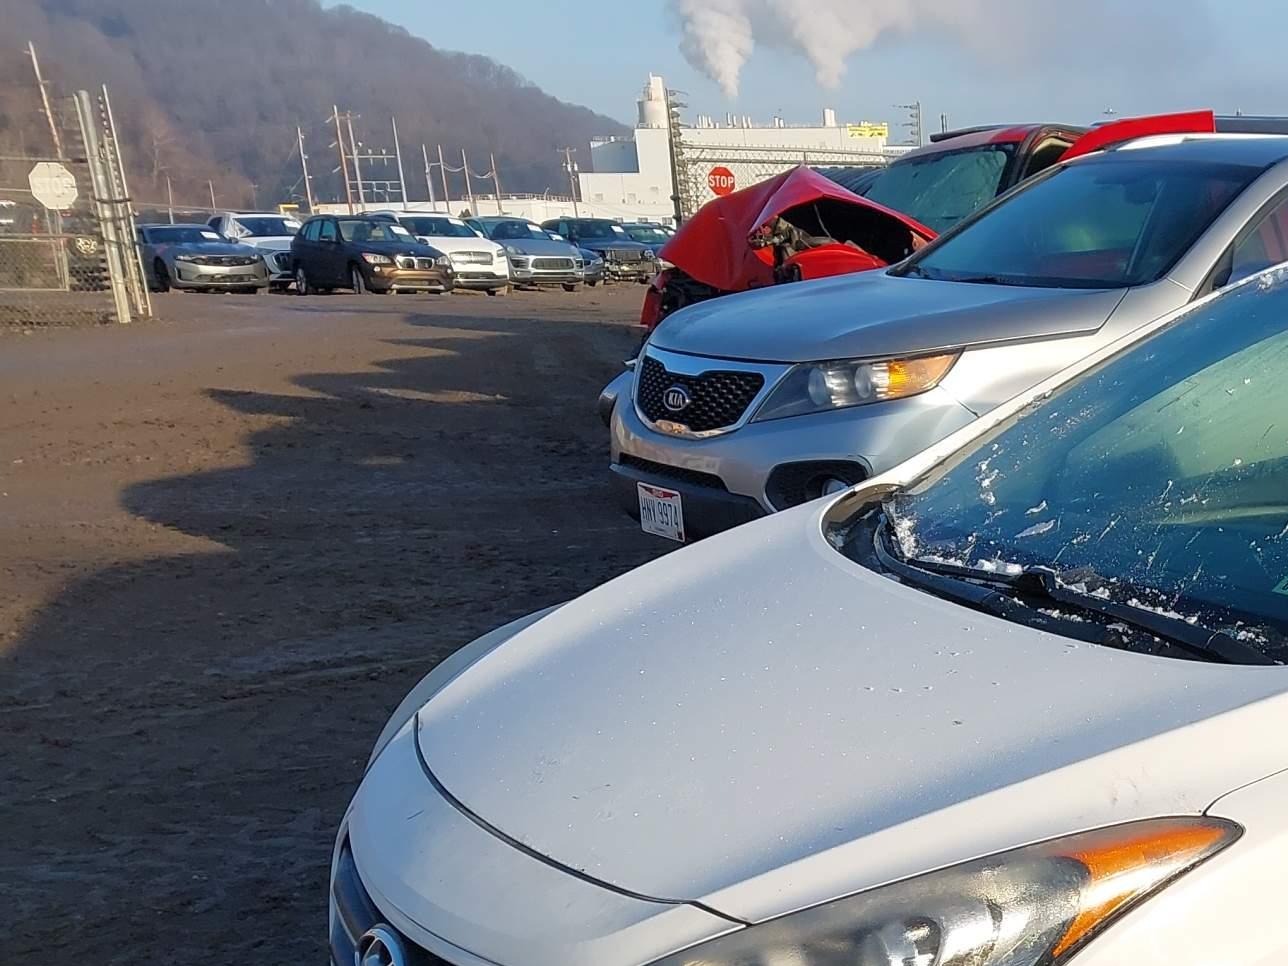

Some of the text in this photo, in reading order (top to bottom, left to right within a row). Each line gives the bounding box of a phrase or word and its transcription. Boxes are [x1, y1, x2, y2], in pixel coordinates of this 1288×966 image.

[709, 175, 734, 188] STOP
[669, 392, 683, 407] KIA
[657, 501, 679, 528] 9974
